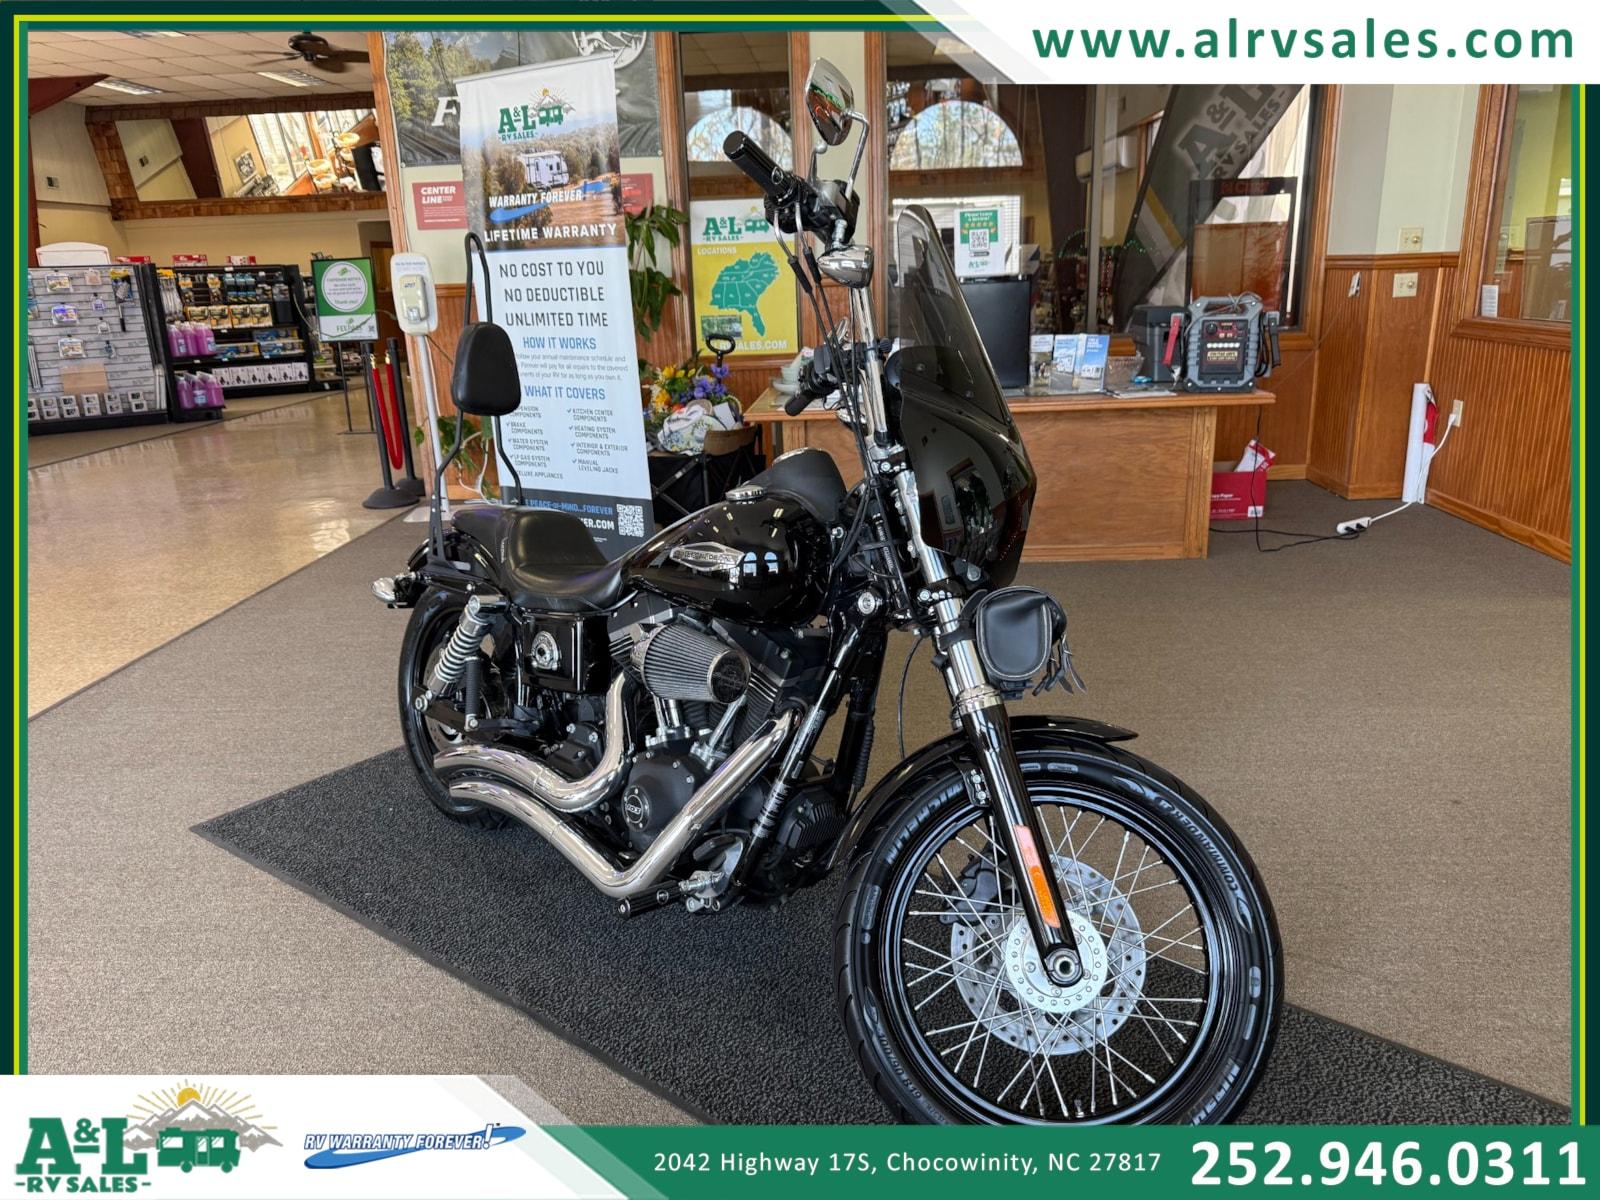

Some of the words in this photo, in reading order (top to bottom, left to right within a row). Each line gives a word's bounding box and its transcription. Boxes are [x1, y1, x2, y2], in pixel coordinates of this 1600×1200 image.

[498, 105, 536, 134] A&L
[512, 131, 535, 140] SALES
[421, 186, 456, 195] CENTER
[422, 195, 442, 204] LINE
[489, 192, 537, 207] WARRANTY
[703, 216, 742, 235] A&L
[484, 227, 538, 242] LIFETIME
[543, 223, 617, 238] WARRANTY
[697, 246, 737, 255] LOCATIONS
[499, 264, 517, 278] NO
[521, 262, 553, 277] COST
[557, 261, 573, 276] TO
[576, 260, 604, 276] YOU
[504, 288, 522, 302] NO
[526, 286, 605, 302] DEDUCTIBLE
[505, 312, 574, 327] UNLIMITED
[577, 312, 609, 327] TIME
[522, 336, 545, 349] HOW
[548, 337, 557, 349] IT
[559, 337, 597, 350] WORKS
[524, 385, 553, 397] WHAT
[555, 386, 564, 398] IT
[566, 387, 606, 400] COVERS
[573, 414, 607, 422] COMPONENTS
[511, 427, 543, 435] COMPONENTS
[574, 425, 595, 433] HEATING
[575, 431, 609, 439] COMPONENTS
[576, 448, 611, 456] COMPONENTS
[604, 444, 628, 452] EXTERIOR
[514, 460, 547, 468] COMPONENTS
[578, 465, 601, 473] LEVELING
[602, 466, 618, 474] JACKS
[535, 471, 564, 479] APPLIANCES
[886, 783, 964, 865] MICHELIN
[1172, 808, 1239, 892] COMMANDER
